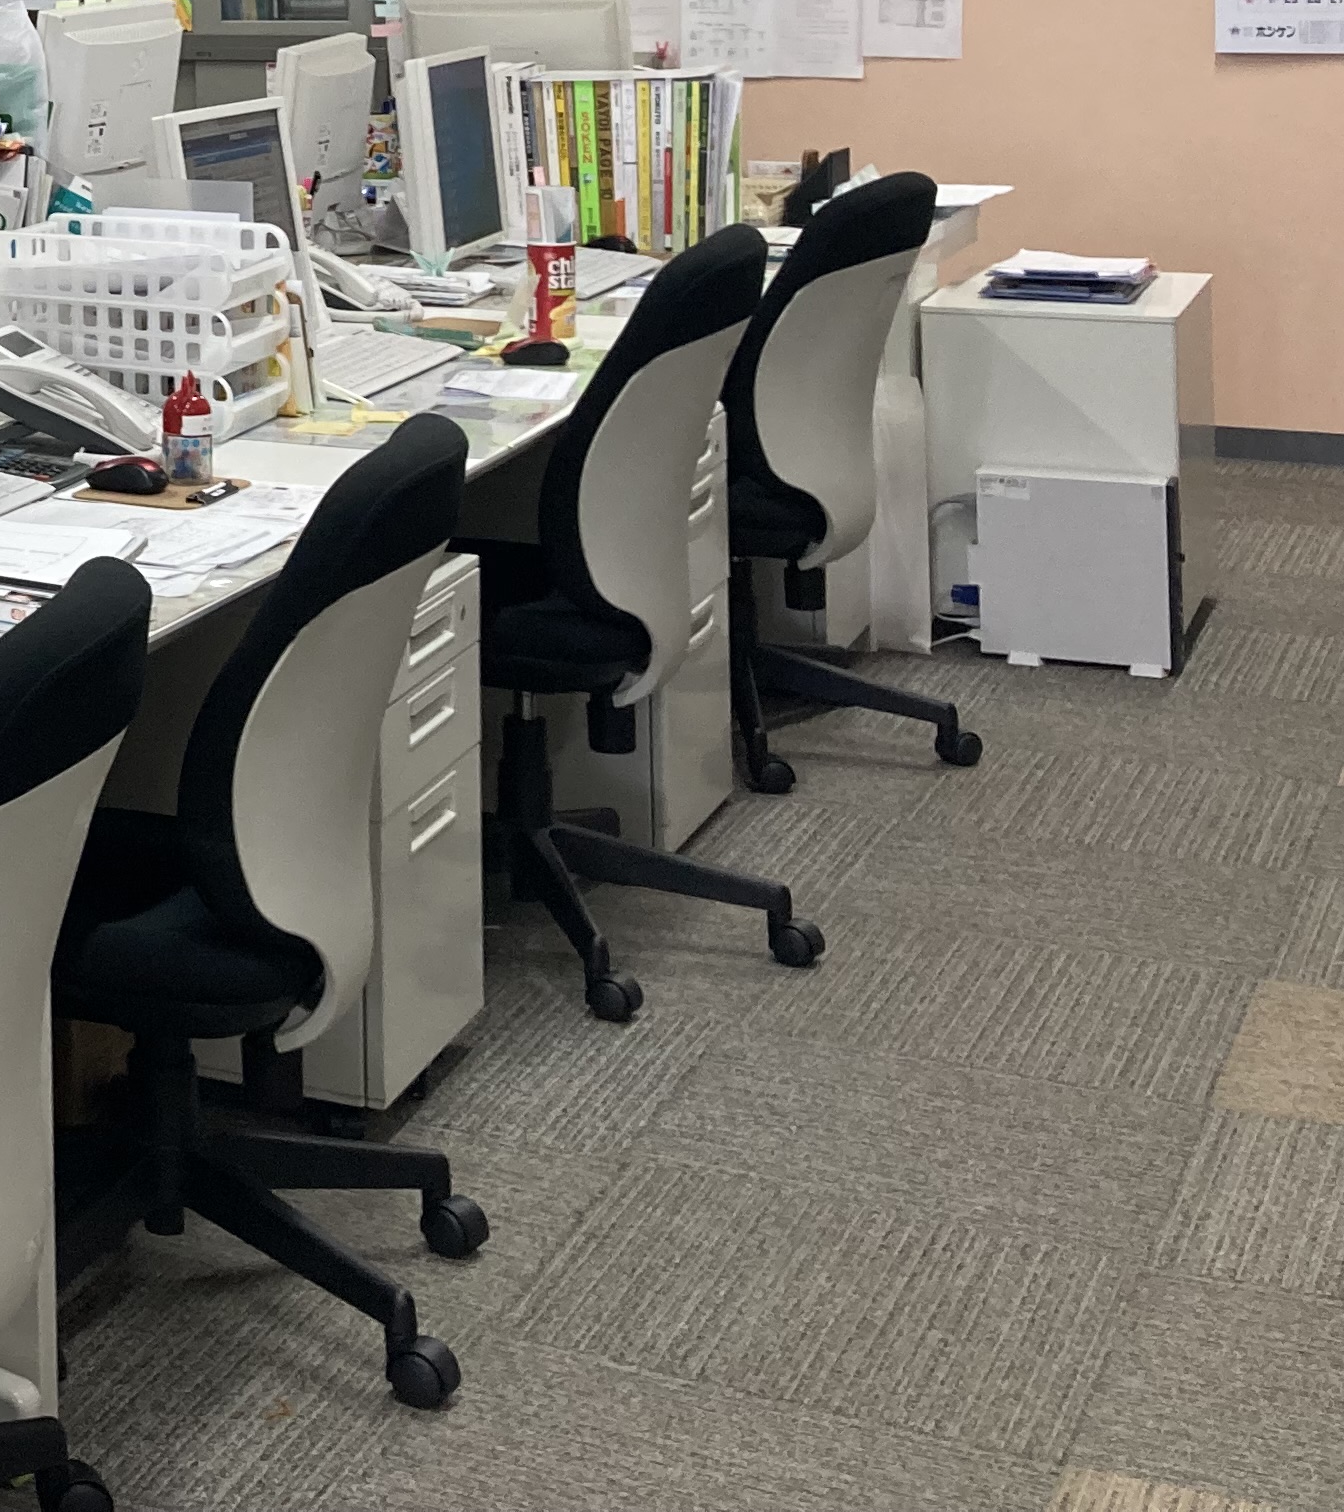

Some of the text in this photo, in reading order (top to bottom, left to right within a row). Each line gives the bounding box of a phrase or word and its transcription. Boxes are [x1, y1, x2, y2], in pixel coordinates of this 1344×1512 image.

[1256, 27, 1296, 38] ホシケン
[581, 111, 593, 163] SOKEN
